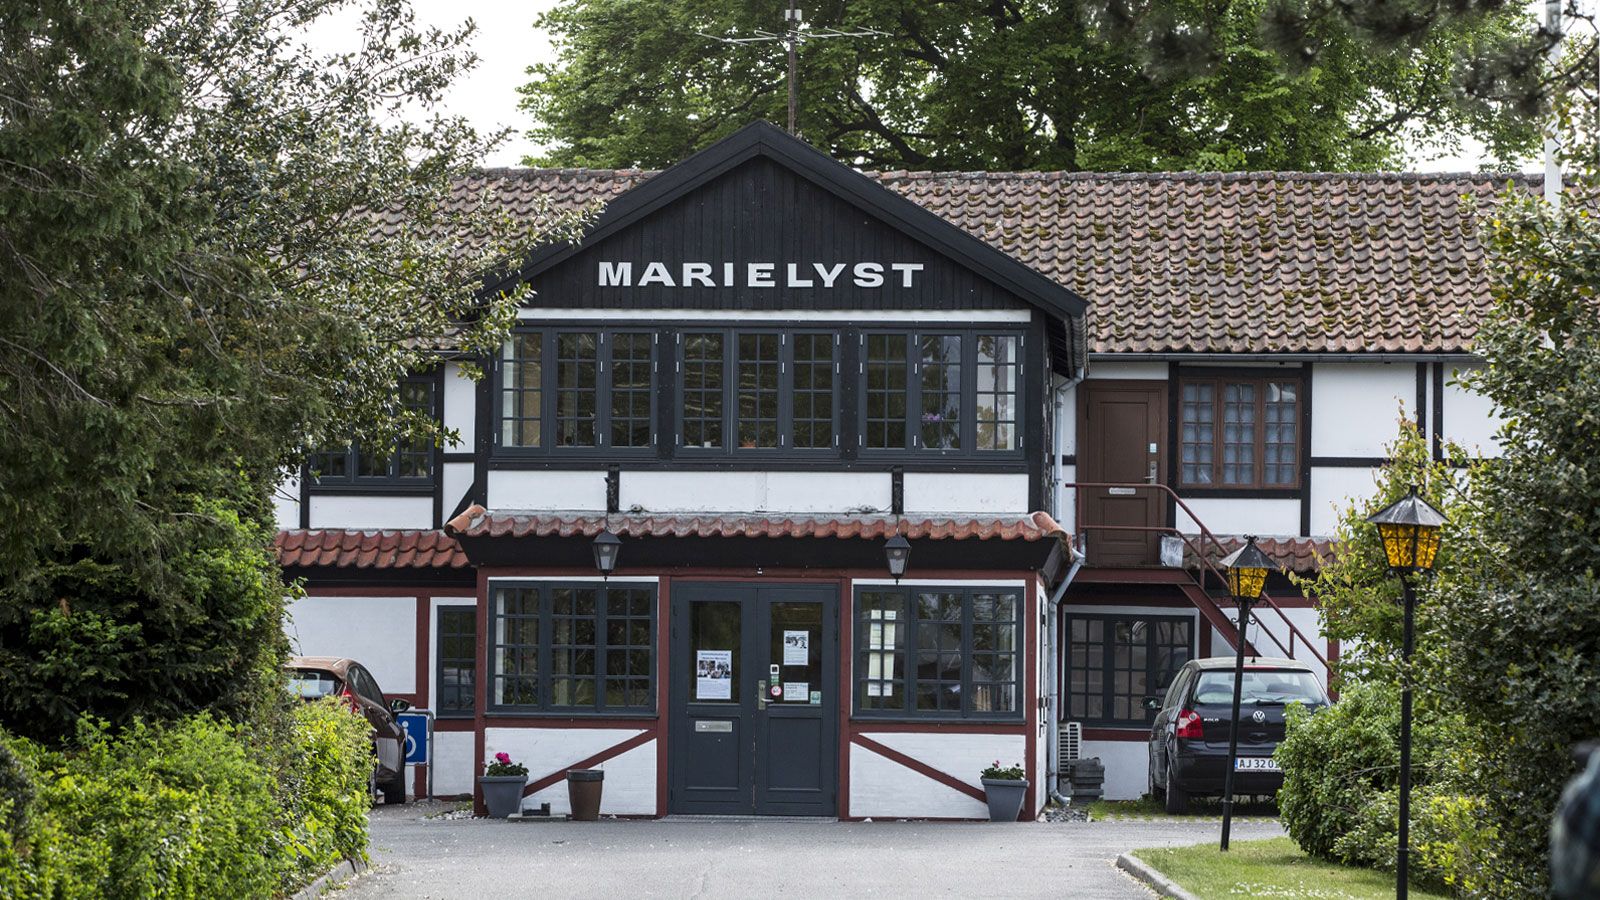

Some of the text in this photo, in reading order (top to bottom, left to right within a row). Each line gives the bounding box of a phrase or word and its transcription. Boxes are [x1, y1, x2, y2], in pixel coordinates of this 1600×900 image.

[598, 261, 924, 288] MARIELYST
[1239, 759, 1252, 769] AJ
[1254, 759, 1266, 769] 32
